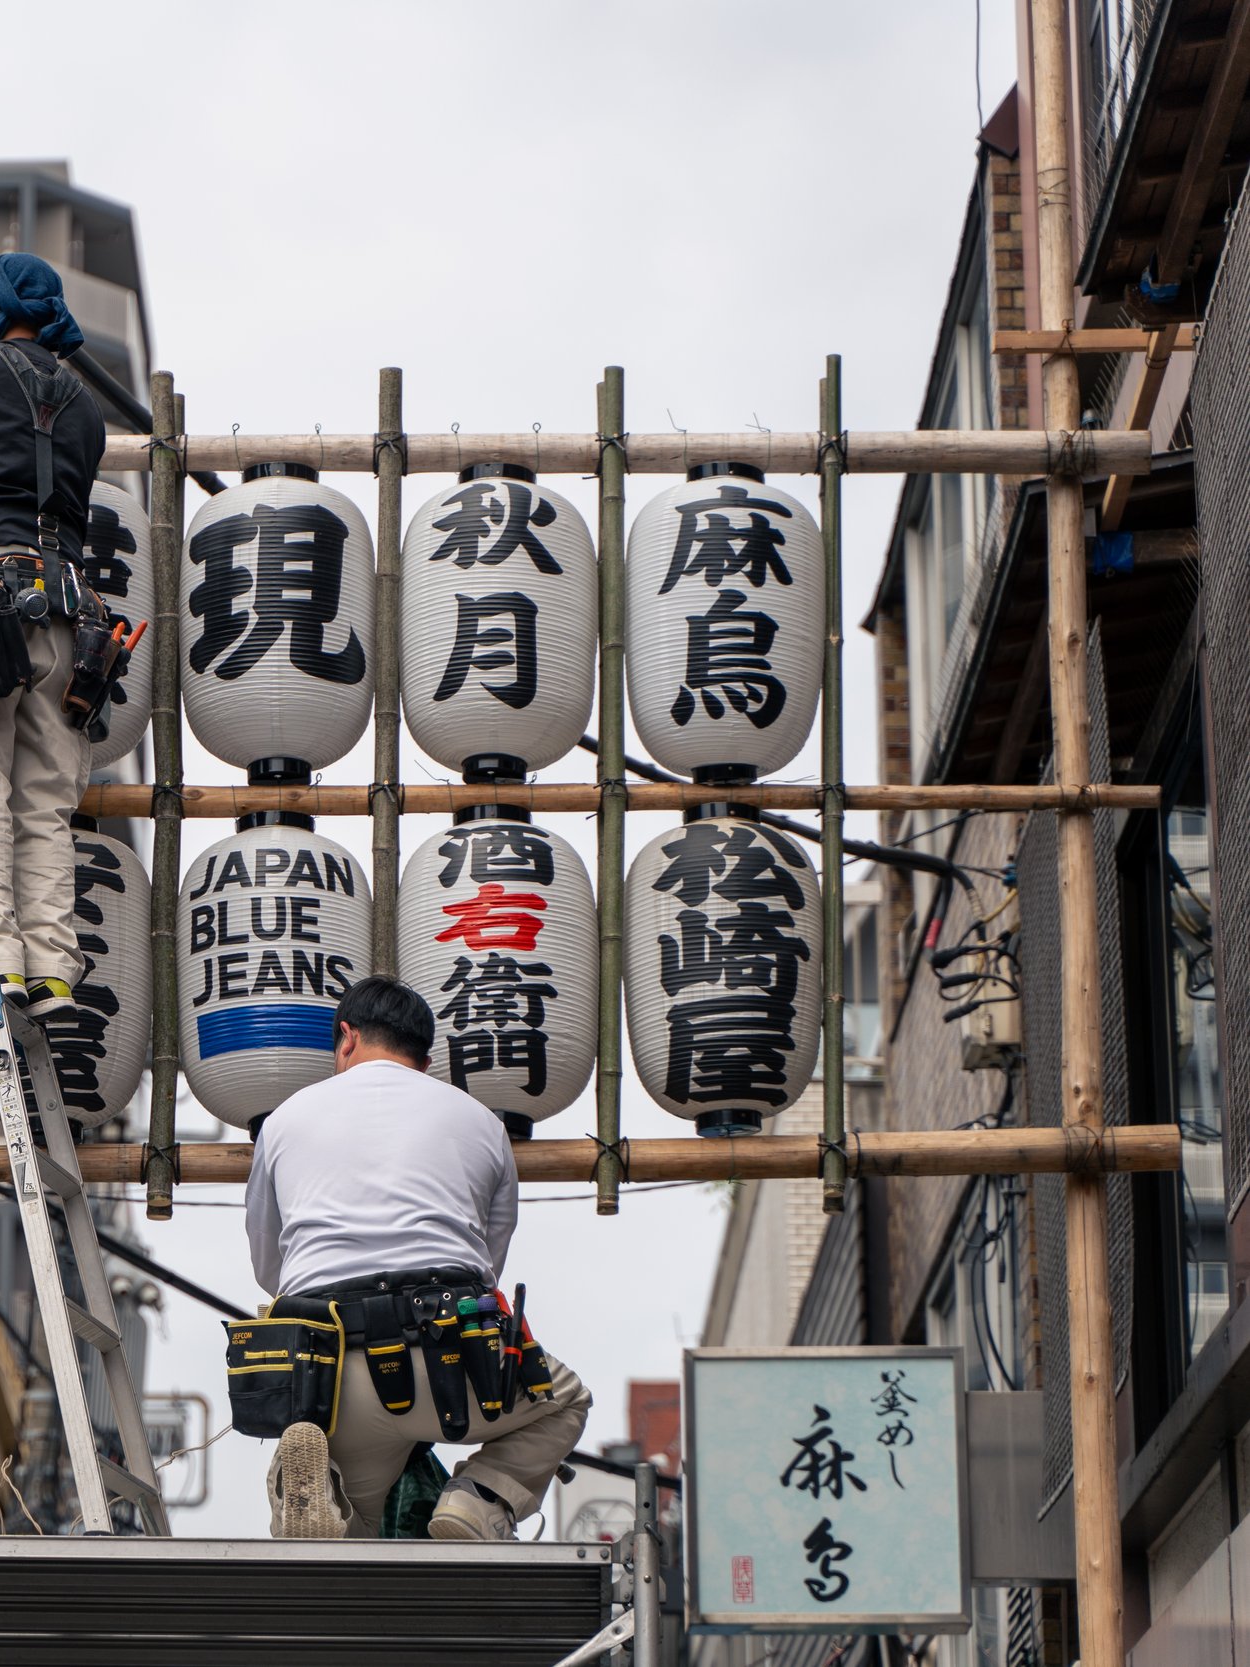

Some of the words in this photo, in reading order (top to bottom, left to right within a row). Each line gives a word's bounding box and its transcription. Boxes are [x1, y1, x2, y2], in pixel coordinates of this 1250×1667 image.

[189, 503, 366, 685] 現
[429, 482, 564, 710] 秋月
[658, 485, 793, 729] 麻鳥
[190, 848, 355, 900] JAPAN
[190, 897, 321, 955] BLUE
[193, 949, 355, 1007] JEANS
[780, 1404, 867, 1602] 麻鳥
[871, 1370, 917, 1490] 釜めし
